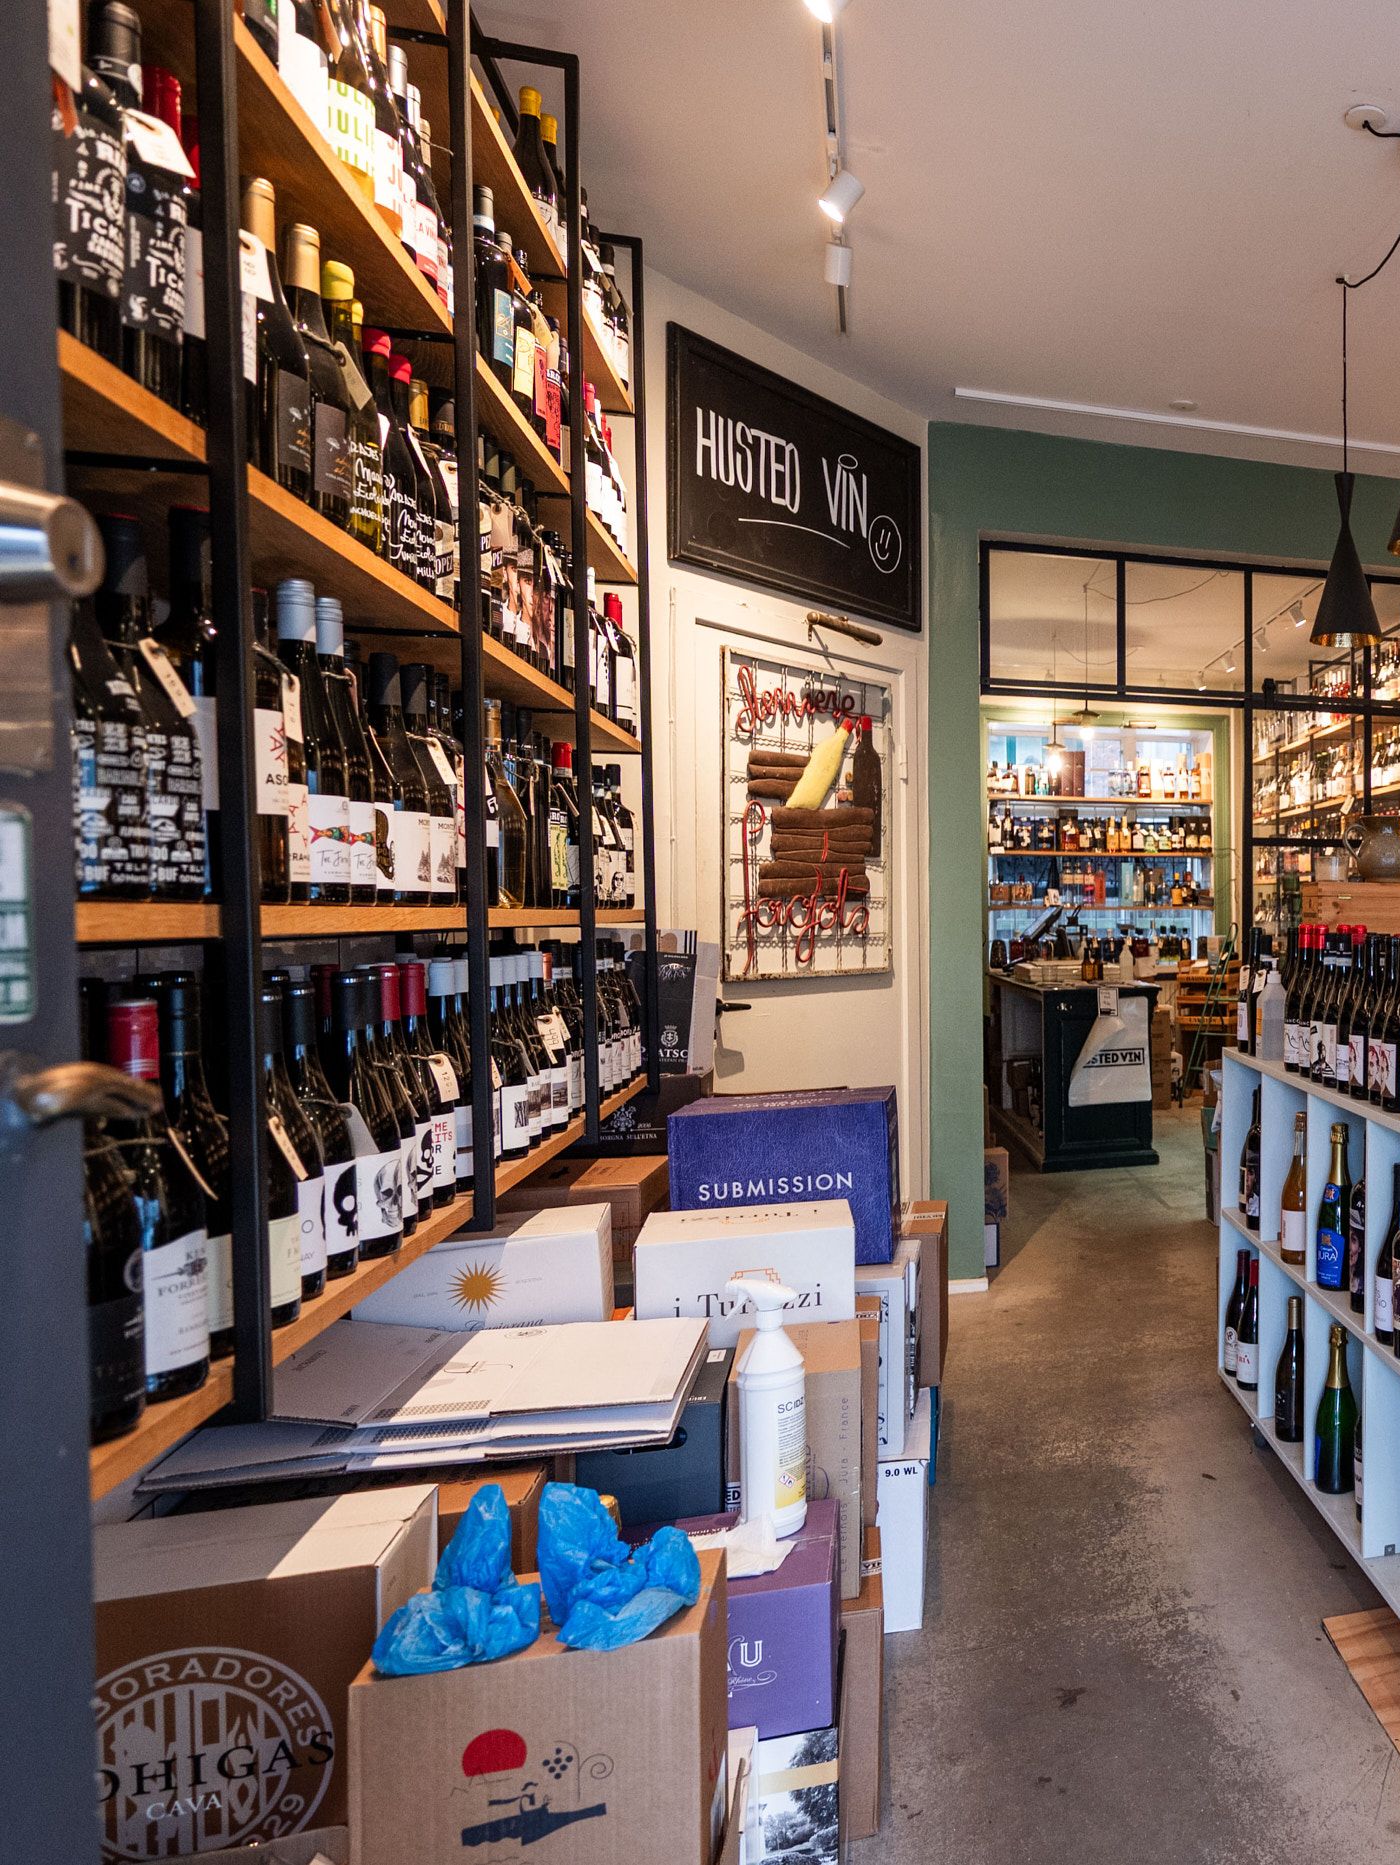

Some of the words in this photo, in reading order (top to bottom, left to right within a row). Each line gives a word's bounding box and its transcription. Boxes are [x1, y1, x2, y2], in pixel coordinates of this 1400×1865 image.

[696, 406, 800, 514] HUSTED
[821, 454, 868, 539] VIN
[1121, 1051, 1142, 1064] VIN
[698, 1171, 854, 1202] SUBMISSION
[839, 1397, 849, 1440] France
[884, 1468, 900, 1478] 9.0
[903, 1466, 918, 1476] WL
[146, 1793, 223, 1821] CAVA
